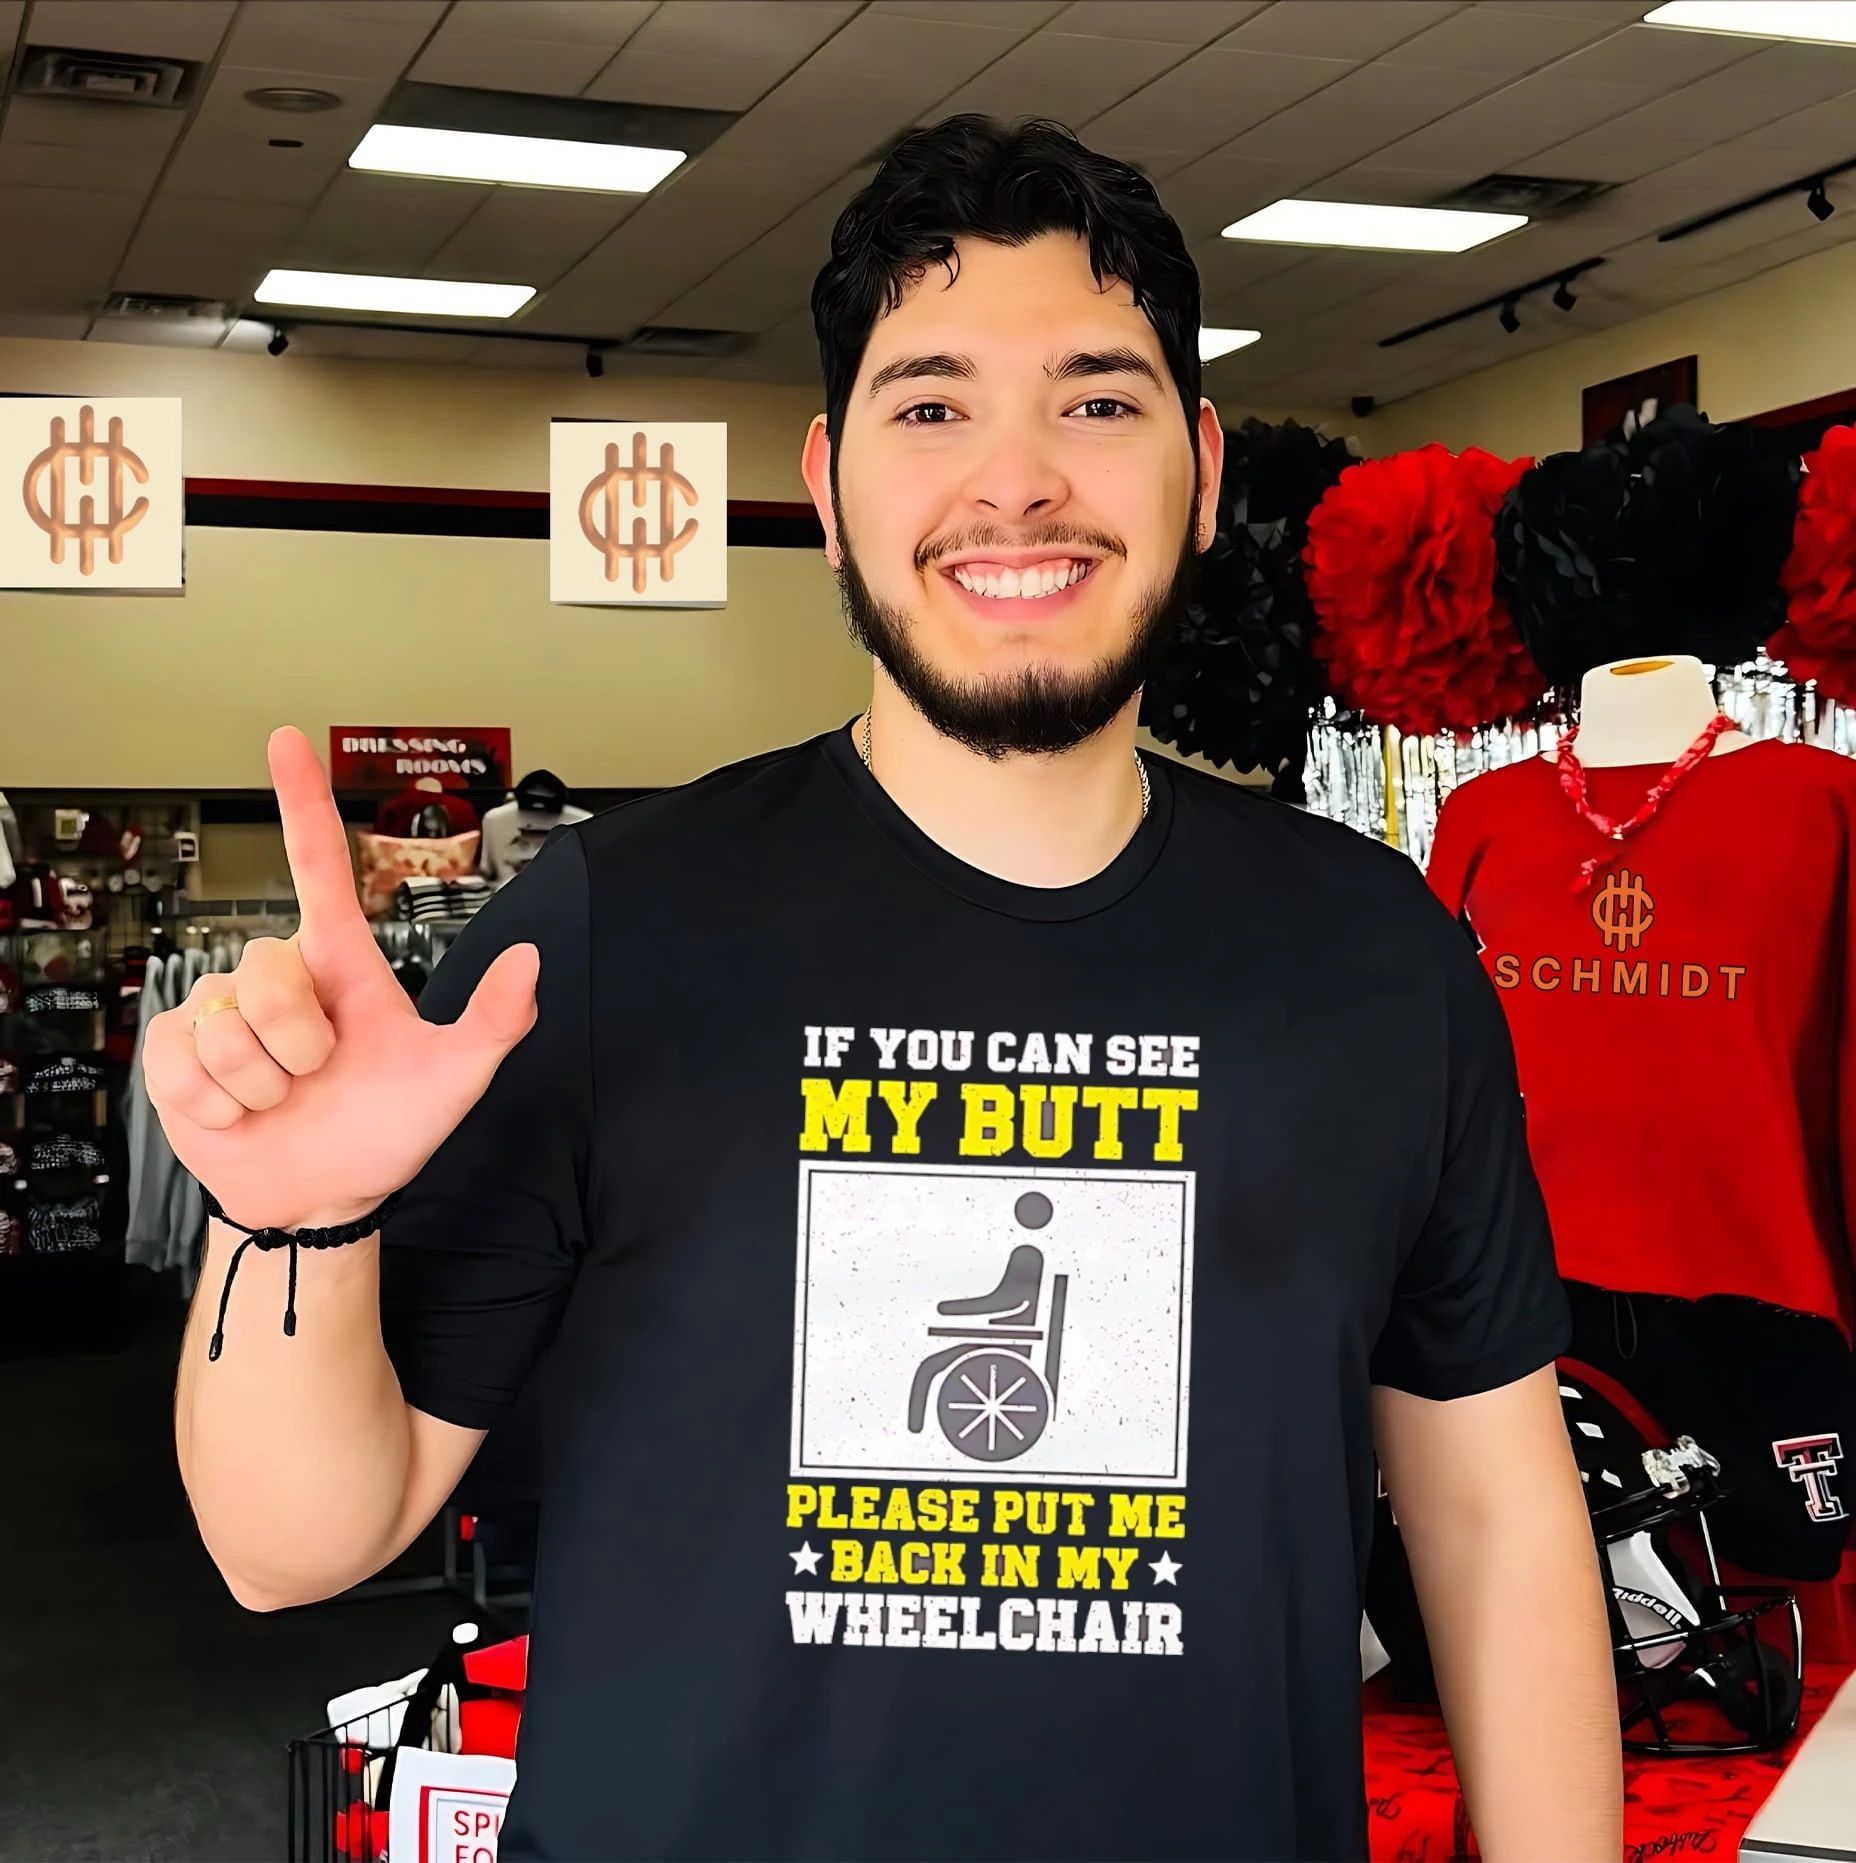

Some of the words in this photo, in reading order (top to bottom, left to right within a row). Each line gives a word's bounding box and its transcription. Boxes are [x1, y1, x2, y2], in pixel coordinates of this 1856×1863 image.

[342, 737, 467, 754] DRESSING
[396, 758, 487, 775] ROOMS
[1494, 953, 1747, 1001] SCHMIDT
[803, 1025, 856, 1068] IF
[869, 1027, 975, 1072] YOU
[986, 1031, 1093, 1076] CAN
[1105, 1034, 1200, 1078] SEE
[799, 1078, 938, 1154] MY
[958, 1082, 1199, 1162] BUTT
[785, 1484, 980, 1533] PLEASE
[992, 1490, 1096, 1536] PUT
[1108, 1493, 1186, 1539] ME
[830, 1539, 967, 1586] BACK
[980, 1543, 1041, 1588] IN
[1056, 1546, 1140, 1590] MY
[785, 1590, 1185, 1656] WHEELCHAIR
